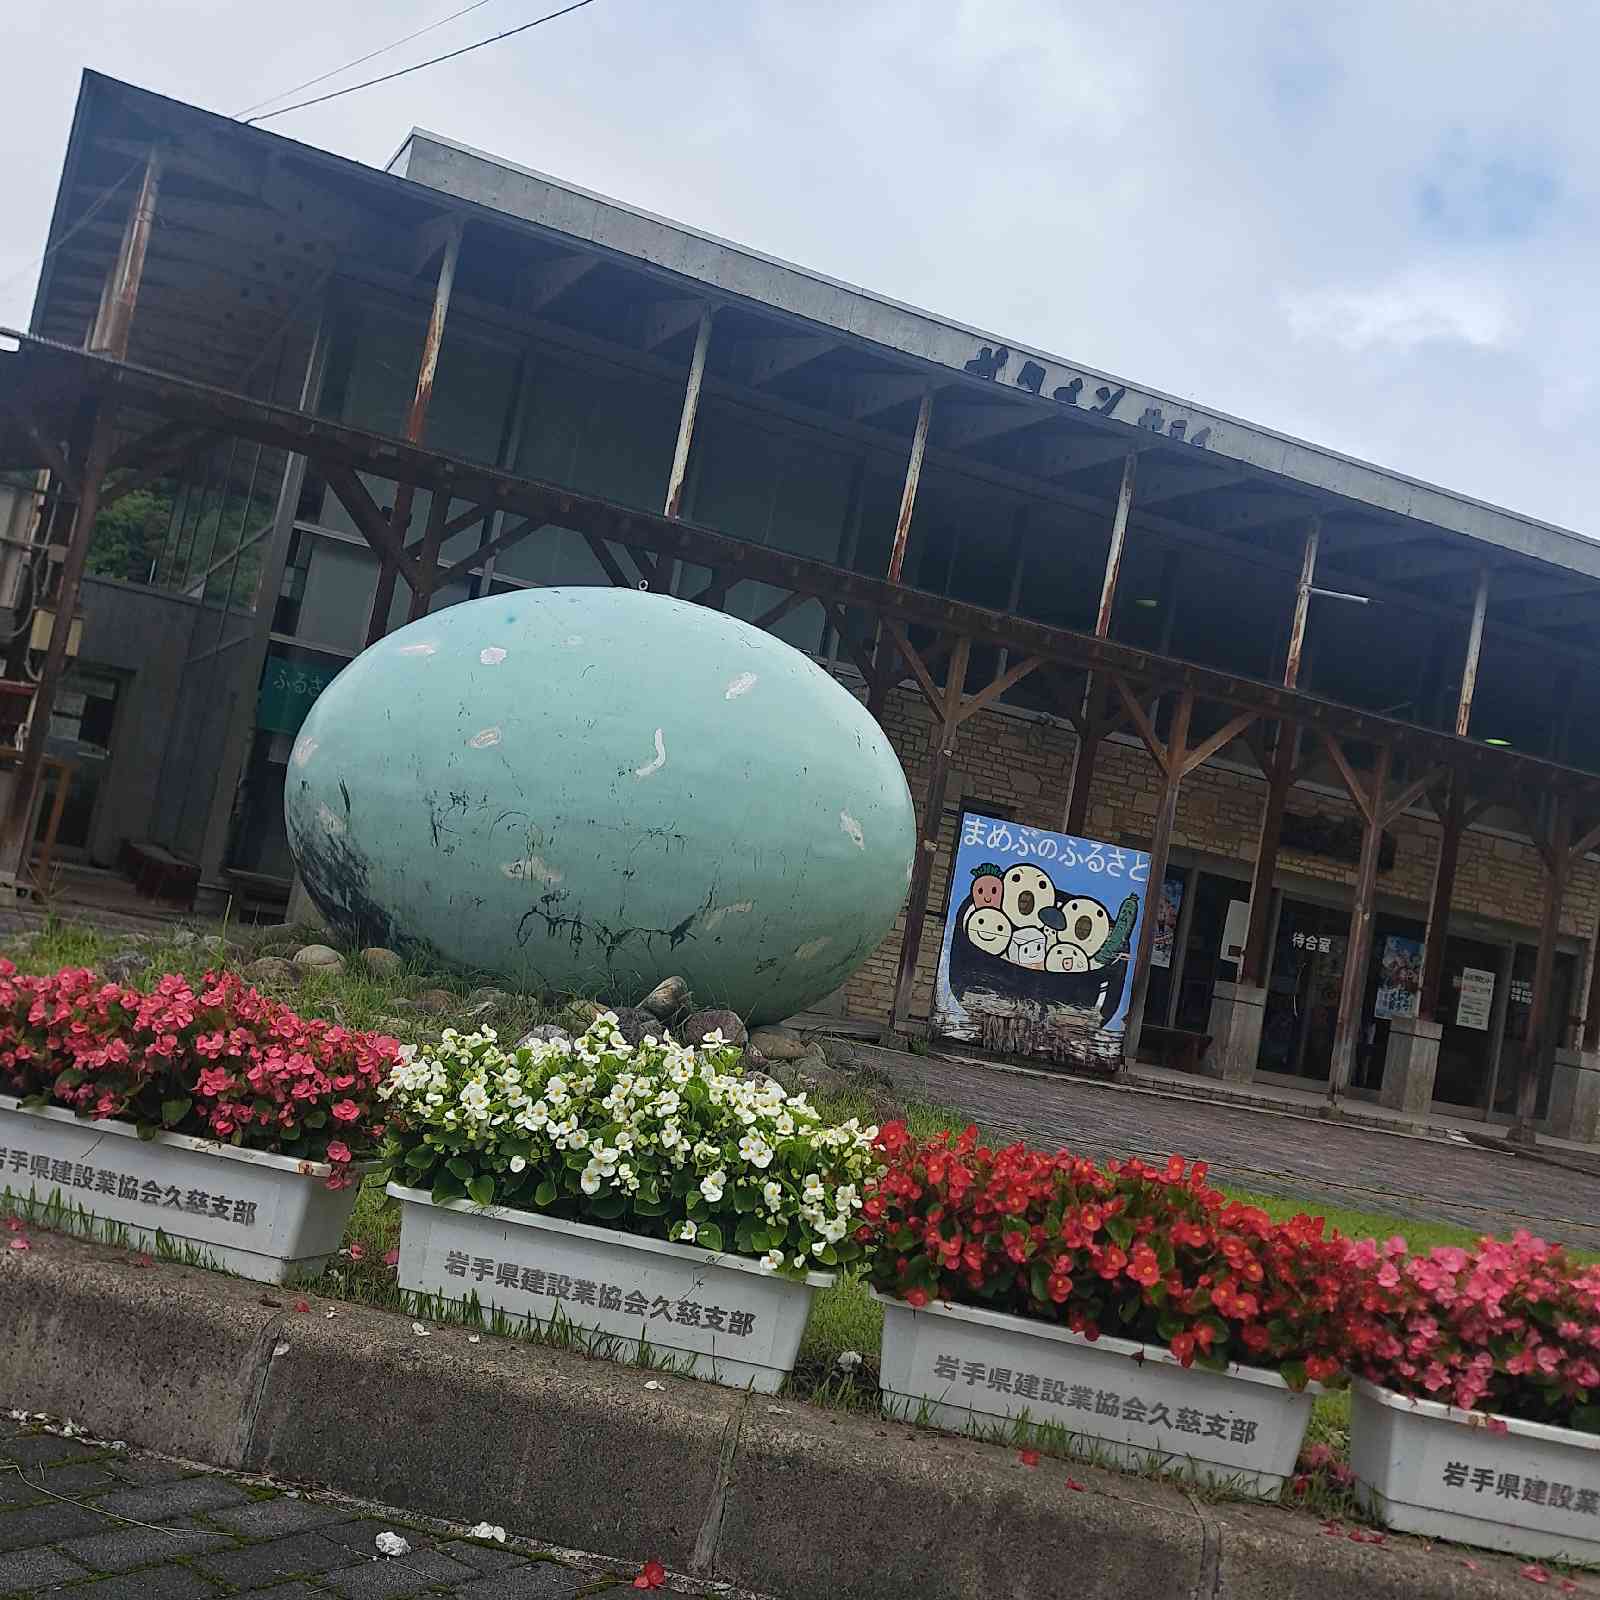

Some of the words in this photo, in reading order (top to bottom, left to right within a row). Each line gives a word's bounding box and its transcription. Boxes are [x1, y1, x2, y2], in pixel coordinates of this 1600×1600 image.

[963, 818, 1148, 882] まめぶのふるさと
[443, 1250, 757, 1337] 岩手県建設業協会久慈支部
[933, 1353, 1259, 1445] 岩手県建設業協会久慈支部
[1442, 1461, 1600, 1516] 岩手県建設業
